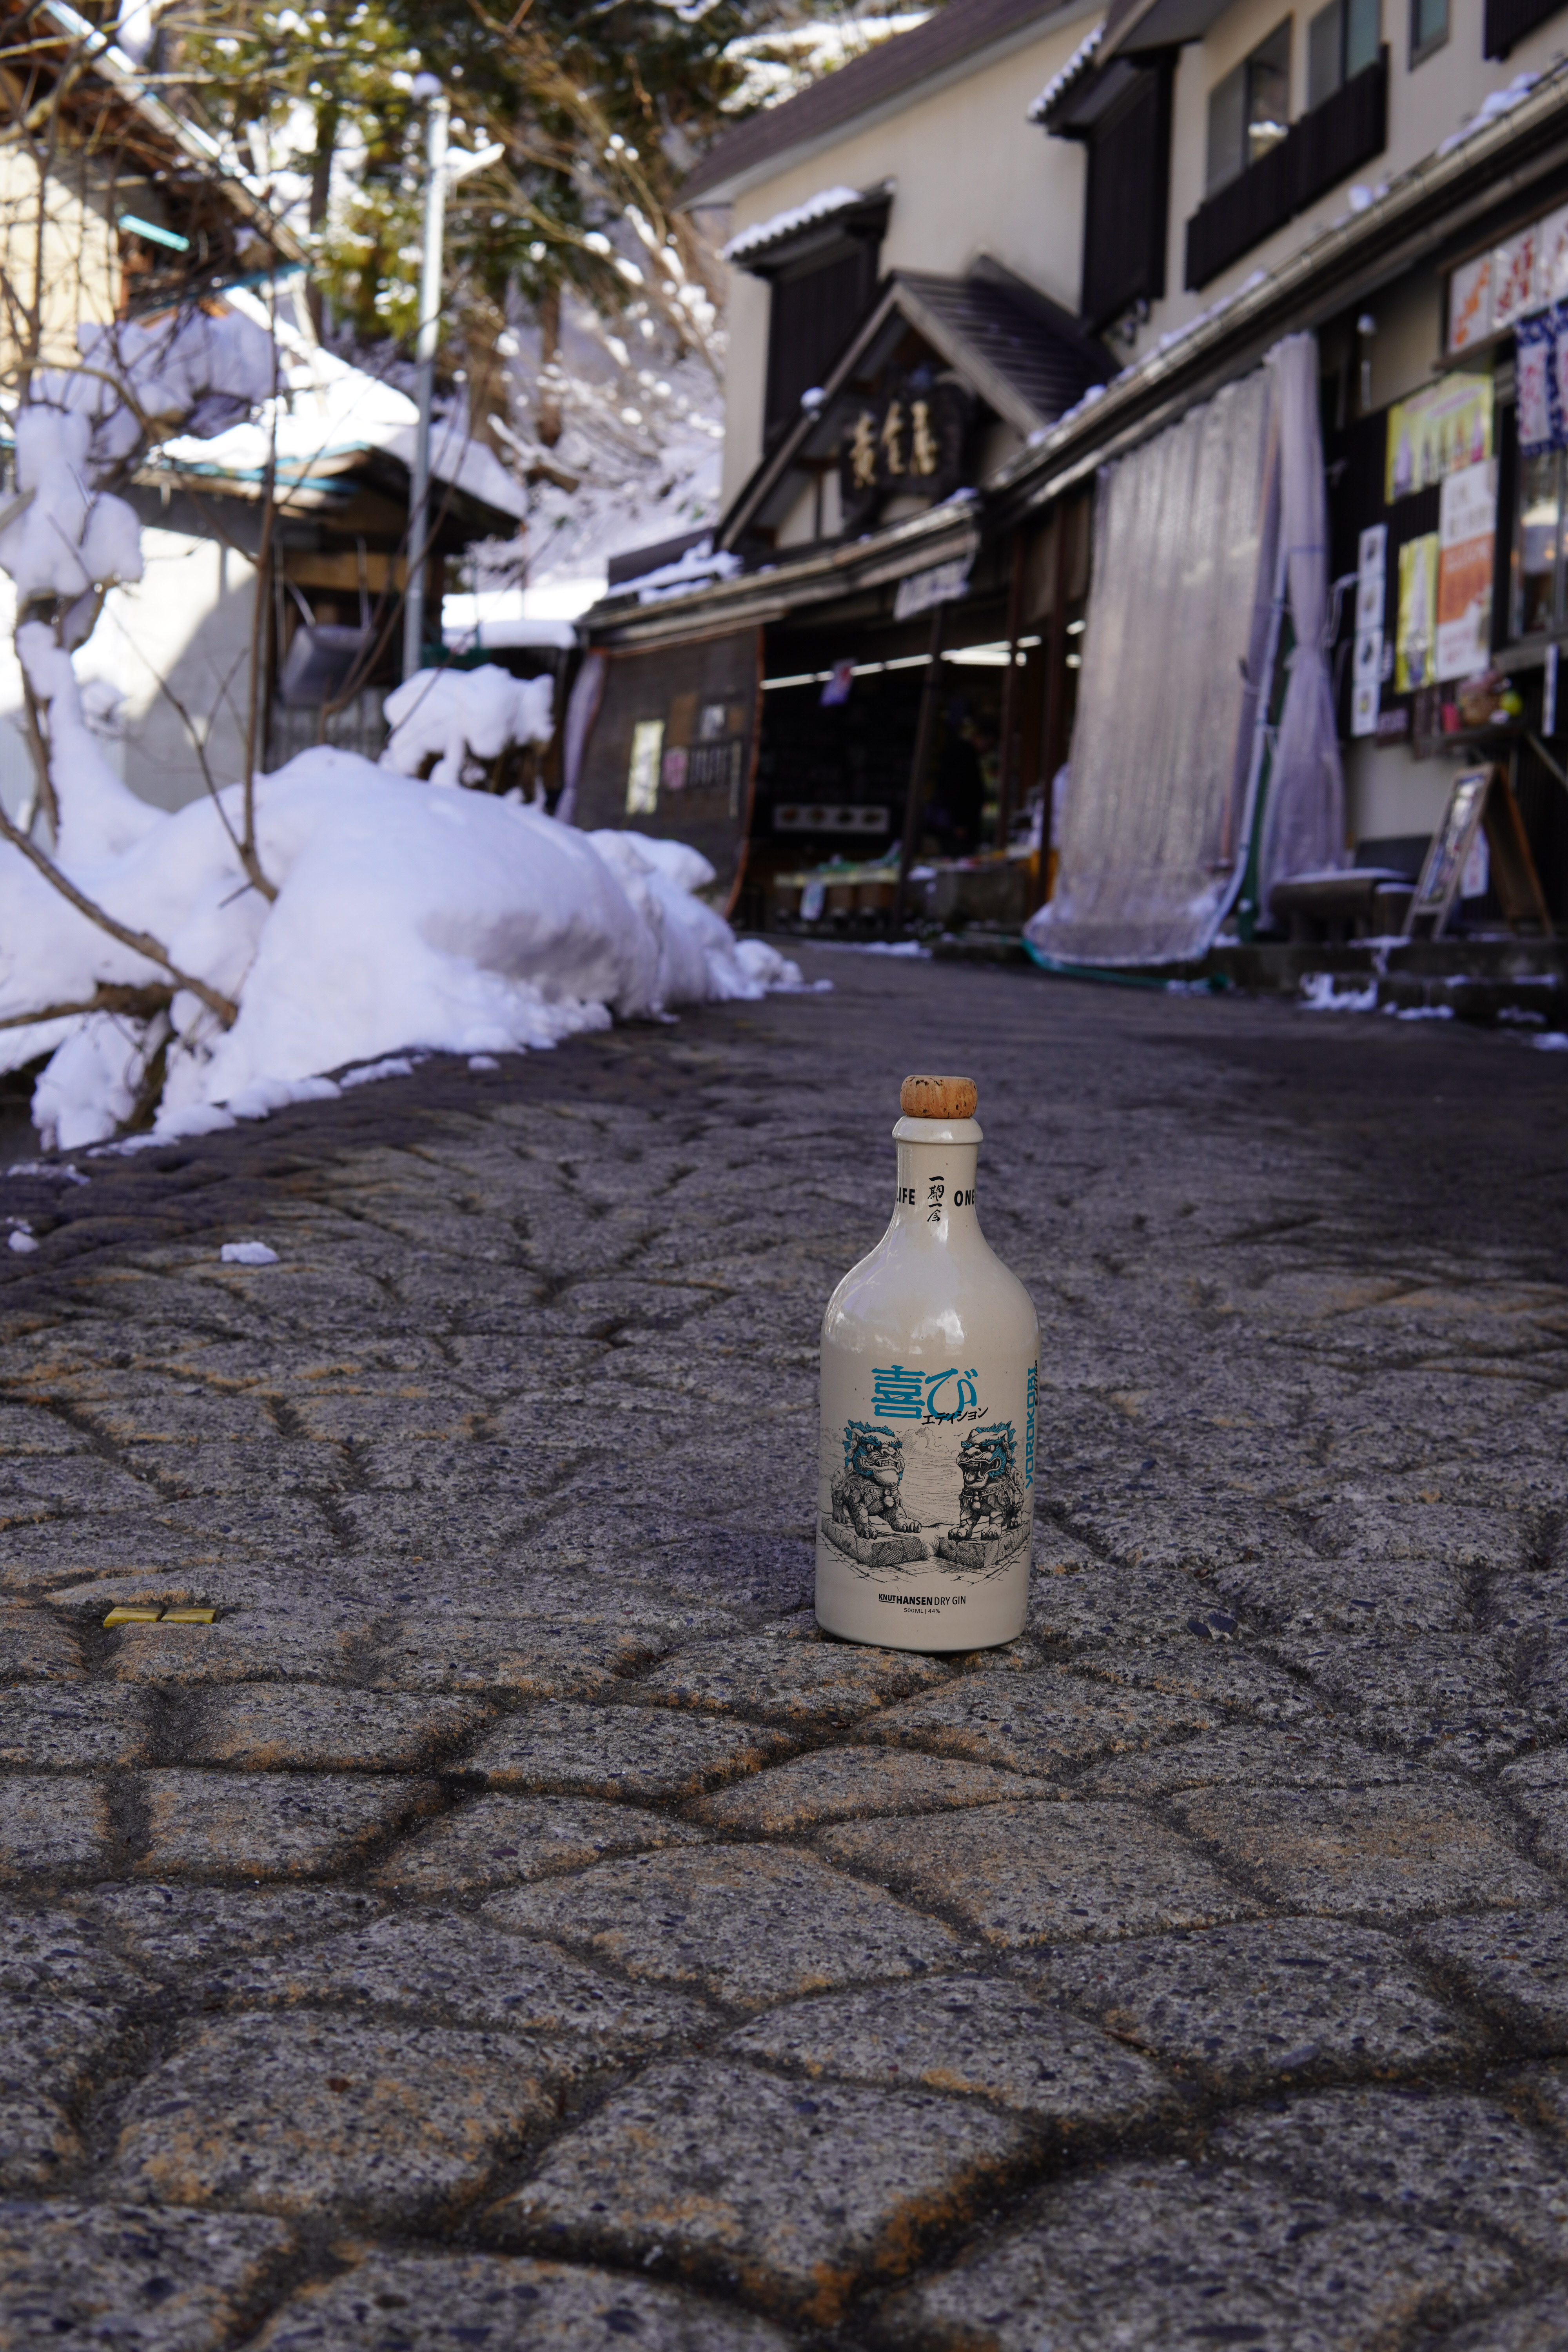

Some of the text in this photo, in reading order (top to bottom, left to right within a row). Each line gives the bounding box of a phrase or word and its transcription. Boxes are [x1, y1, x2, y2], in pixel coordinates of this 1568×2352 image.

[897, 1187, 915, 1205] IFE
[927, 1176, 944, 1222] 一期一会
[871, 1365, 978, 1420] 喜び
[921, 1407, 989, 1426] エディション
[1025, 1367, 1036, 1489] YOROKOBI
[935, 1597, 951, 1605] DRY
[952, 1596, 966, 1605] GIN
